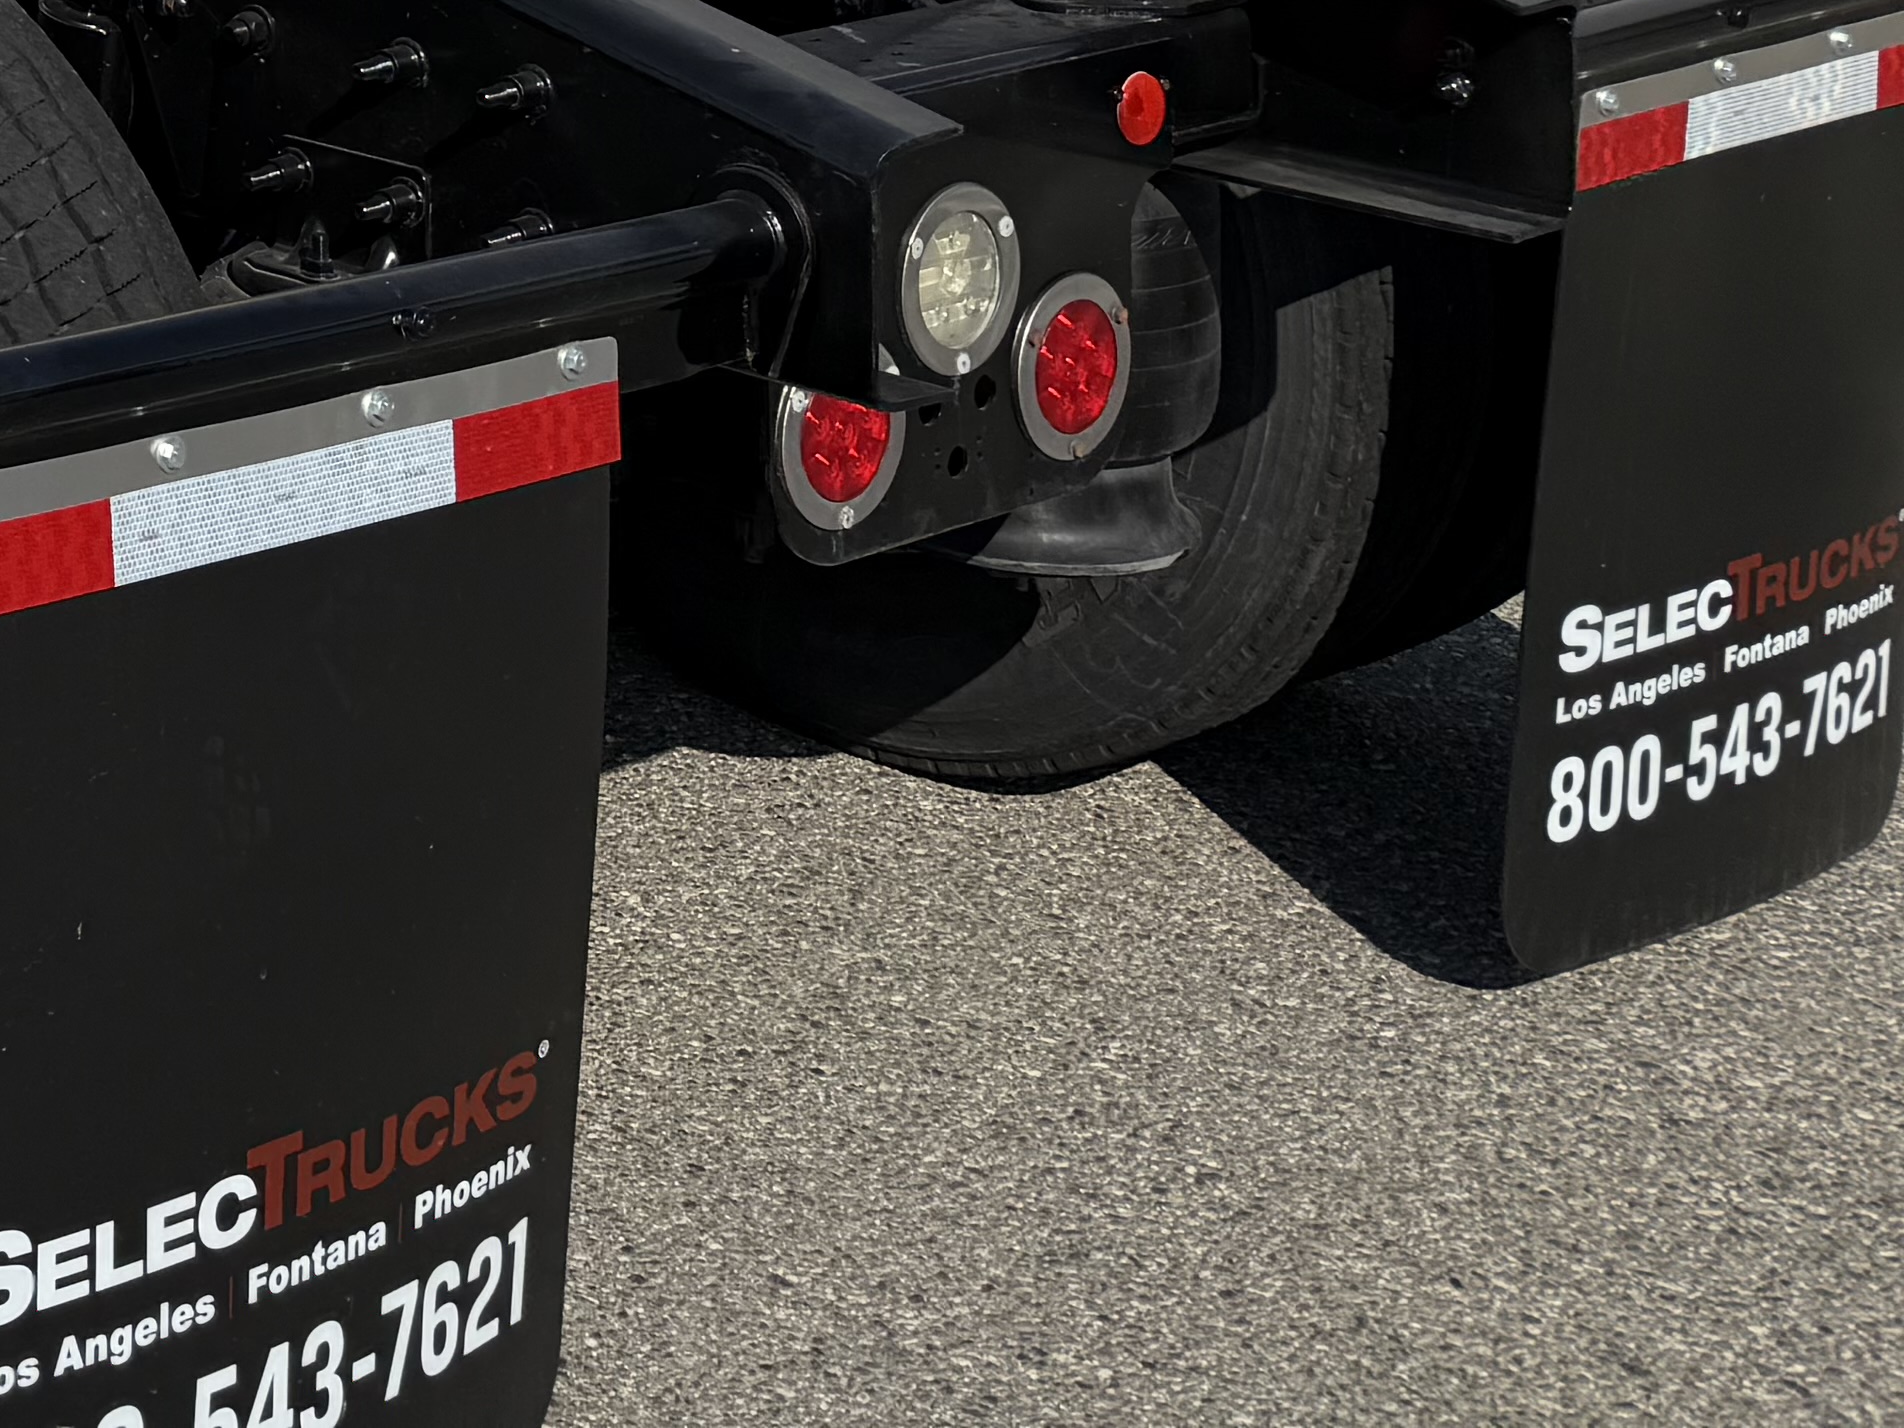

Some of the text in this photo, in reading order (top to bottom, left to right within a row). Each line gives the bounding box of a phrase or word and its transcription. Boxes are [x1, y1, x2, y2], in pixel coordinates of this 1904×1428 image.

[1555, 583, 1895, 725] Los Angeles Fontana Phoenix
[1558, 519, 1898, 674] SELECTRUCKS
[1546, 638, 1892, 844] 800-543-7621
[53, 1294, 216, 1378] Angeles
[247, 1221, 387, 1305] Fontana
[414, 1143, 532, 1230] Phoenix
